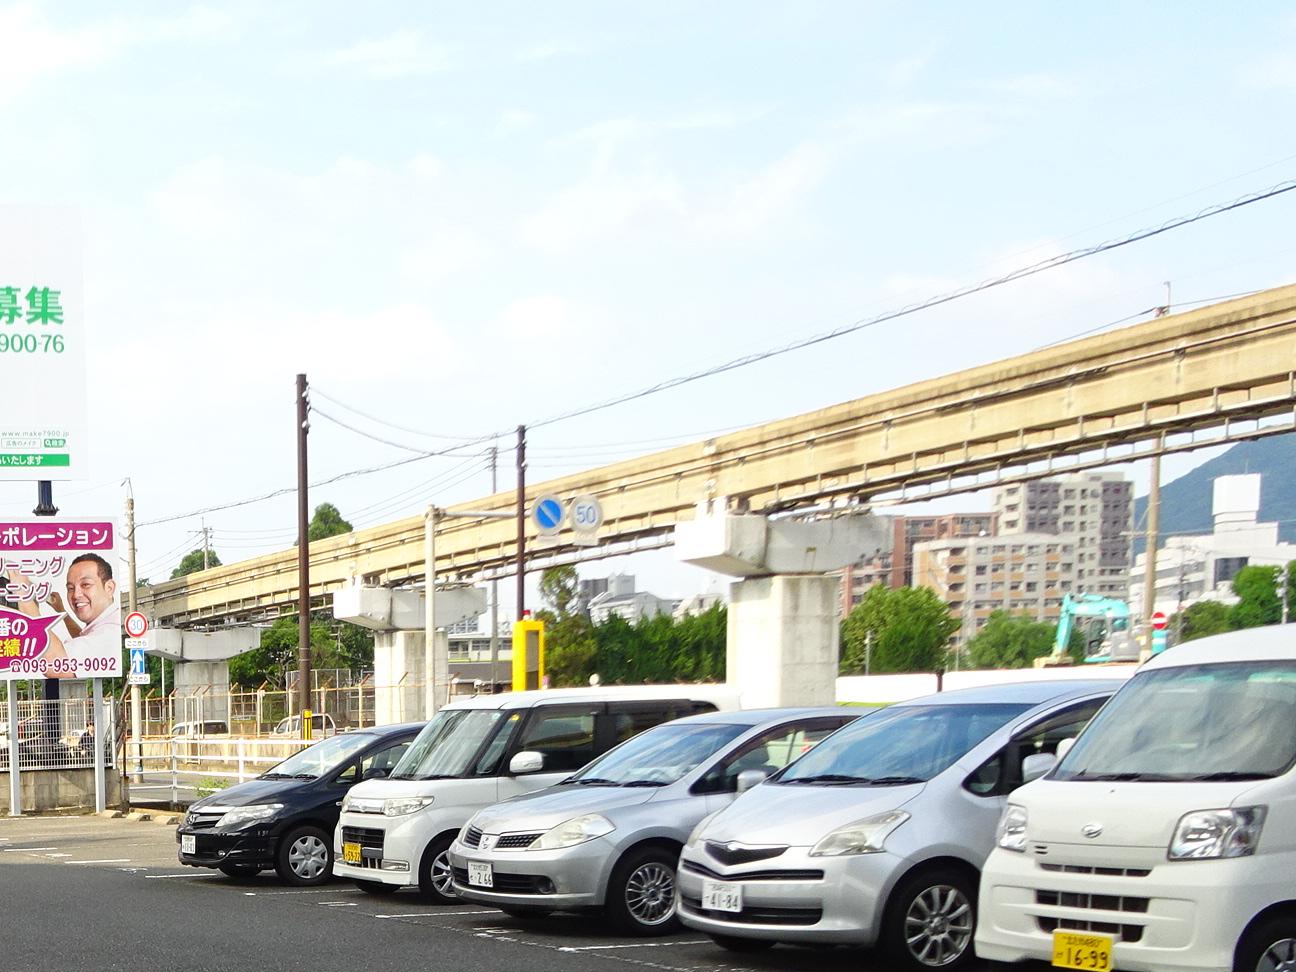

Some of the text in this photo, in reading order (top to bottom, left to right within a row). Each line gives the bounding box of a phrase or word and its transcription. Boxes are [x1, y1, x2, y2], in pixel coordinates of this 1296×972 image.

[576, 505, 596, 524] 50
[130, 619, 143, 631] 30
[22, 657, 117, 673] 093-953-9092
[1067, 948, 1108, 969] 16-99
